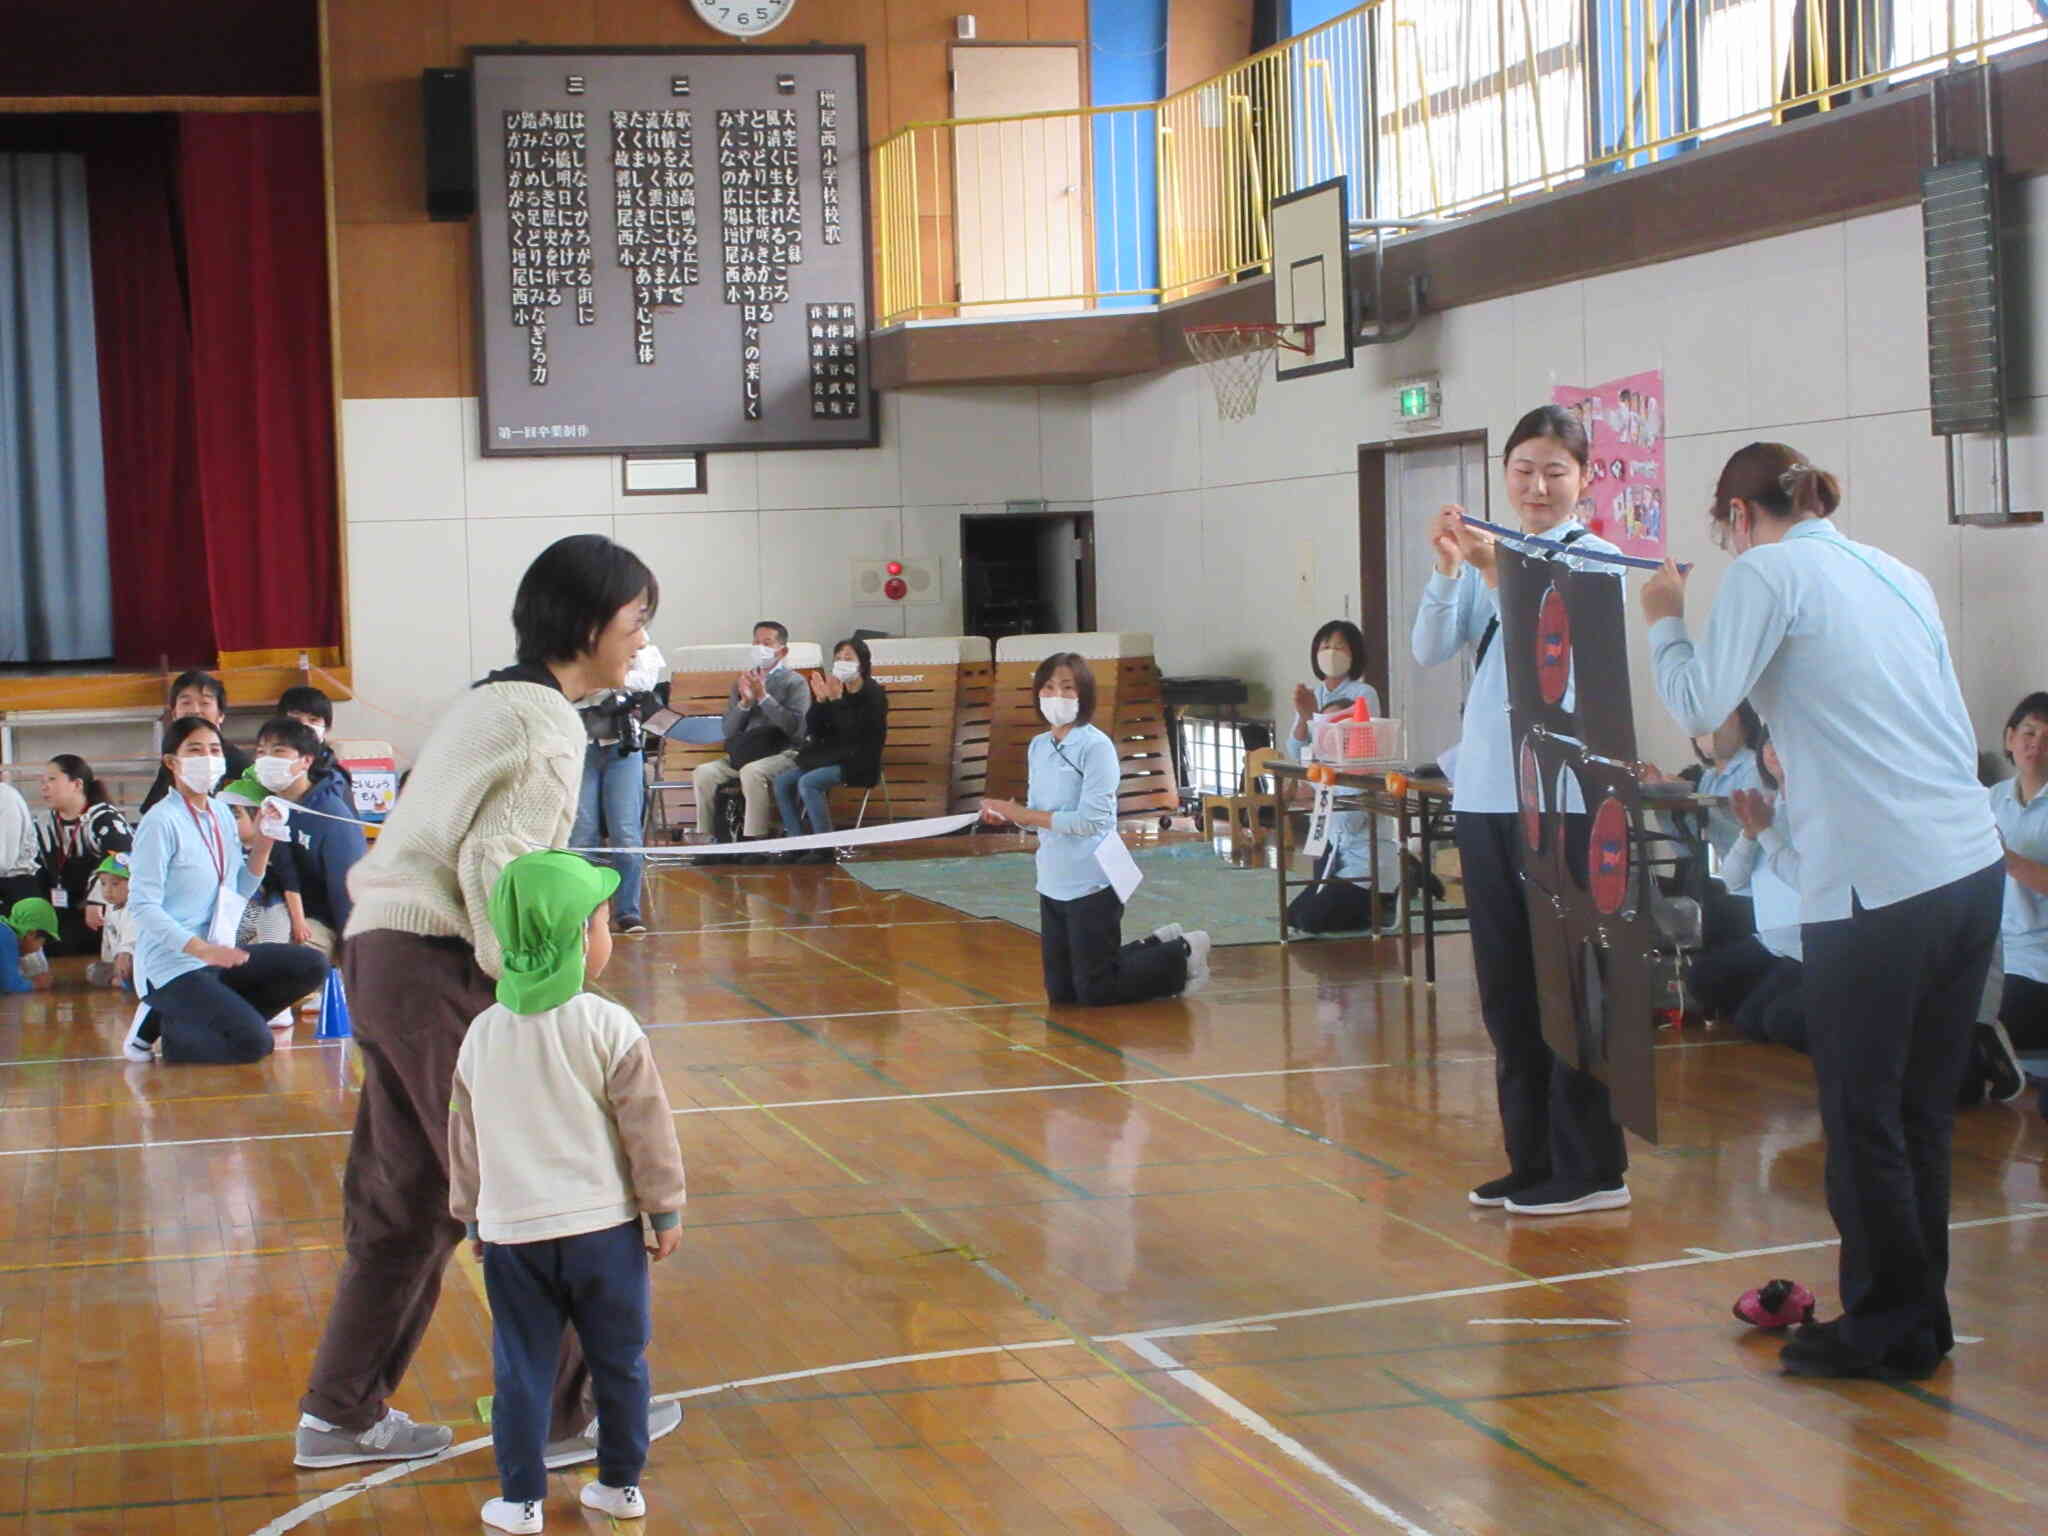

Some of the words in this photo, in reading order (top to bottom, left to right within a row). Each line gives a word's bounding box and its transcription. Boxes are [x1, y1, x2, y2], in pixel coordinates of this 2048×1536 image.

[568, 78, 584, 92] 三
[674, 80, 688, 92] 二
[719, 8, 730, 19] 7
[738, 13, 749, 25] 6
[756, 8, 768, 19] 5
[507, 113, 528, 324] ひかりかがやく増尾西小
[522, 112, 547, 384] 踏みしめる足どりにみなぎる力
[538, 113, 562, 305] あたらしき歴史を作る
[554, 112, 576, 285] 虹の橋明日にかけて
[569, 112, 593, 323] はてしなくひろがる街に
[630, 111, 653, 362] たくましくきたえあう心と体
[662, 111, 684, 303] 友情を永遠にむすんで
[720, 112, 740, 302] みんなの広場増尾西小
[736, 111, 759, 417] すこやかにはげみあう日々の楽しく
[752, 111, 773, 322] とりどりに花咲きかおる
[767, 111, 788, 302] 風清く生まれるところ
[783, 111, 801, 263] 大空にもえたつ緑
